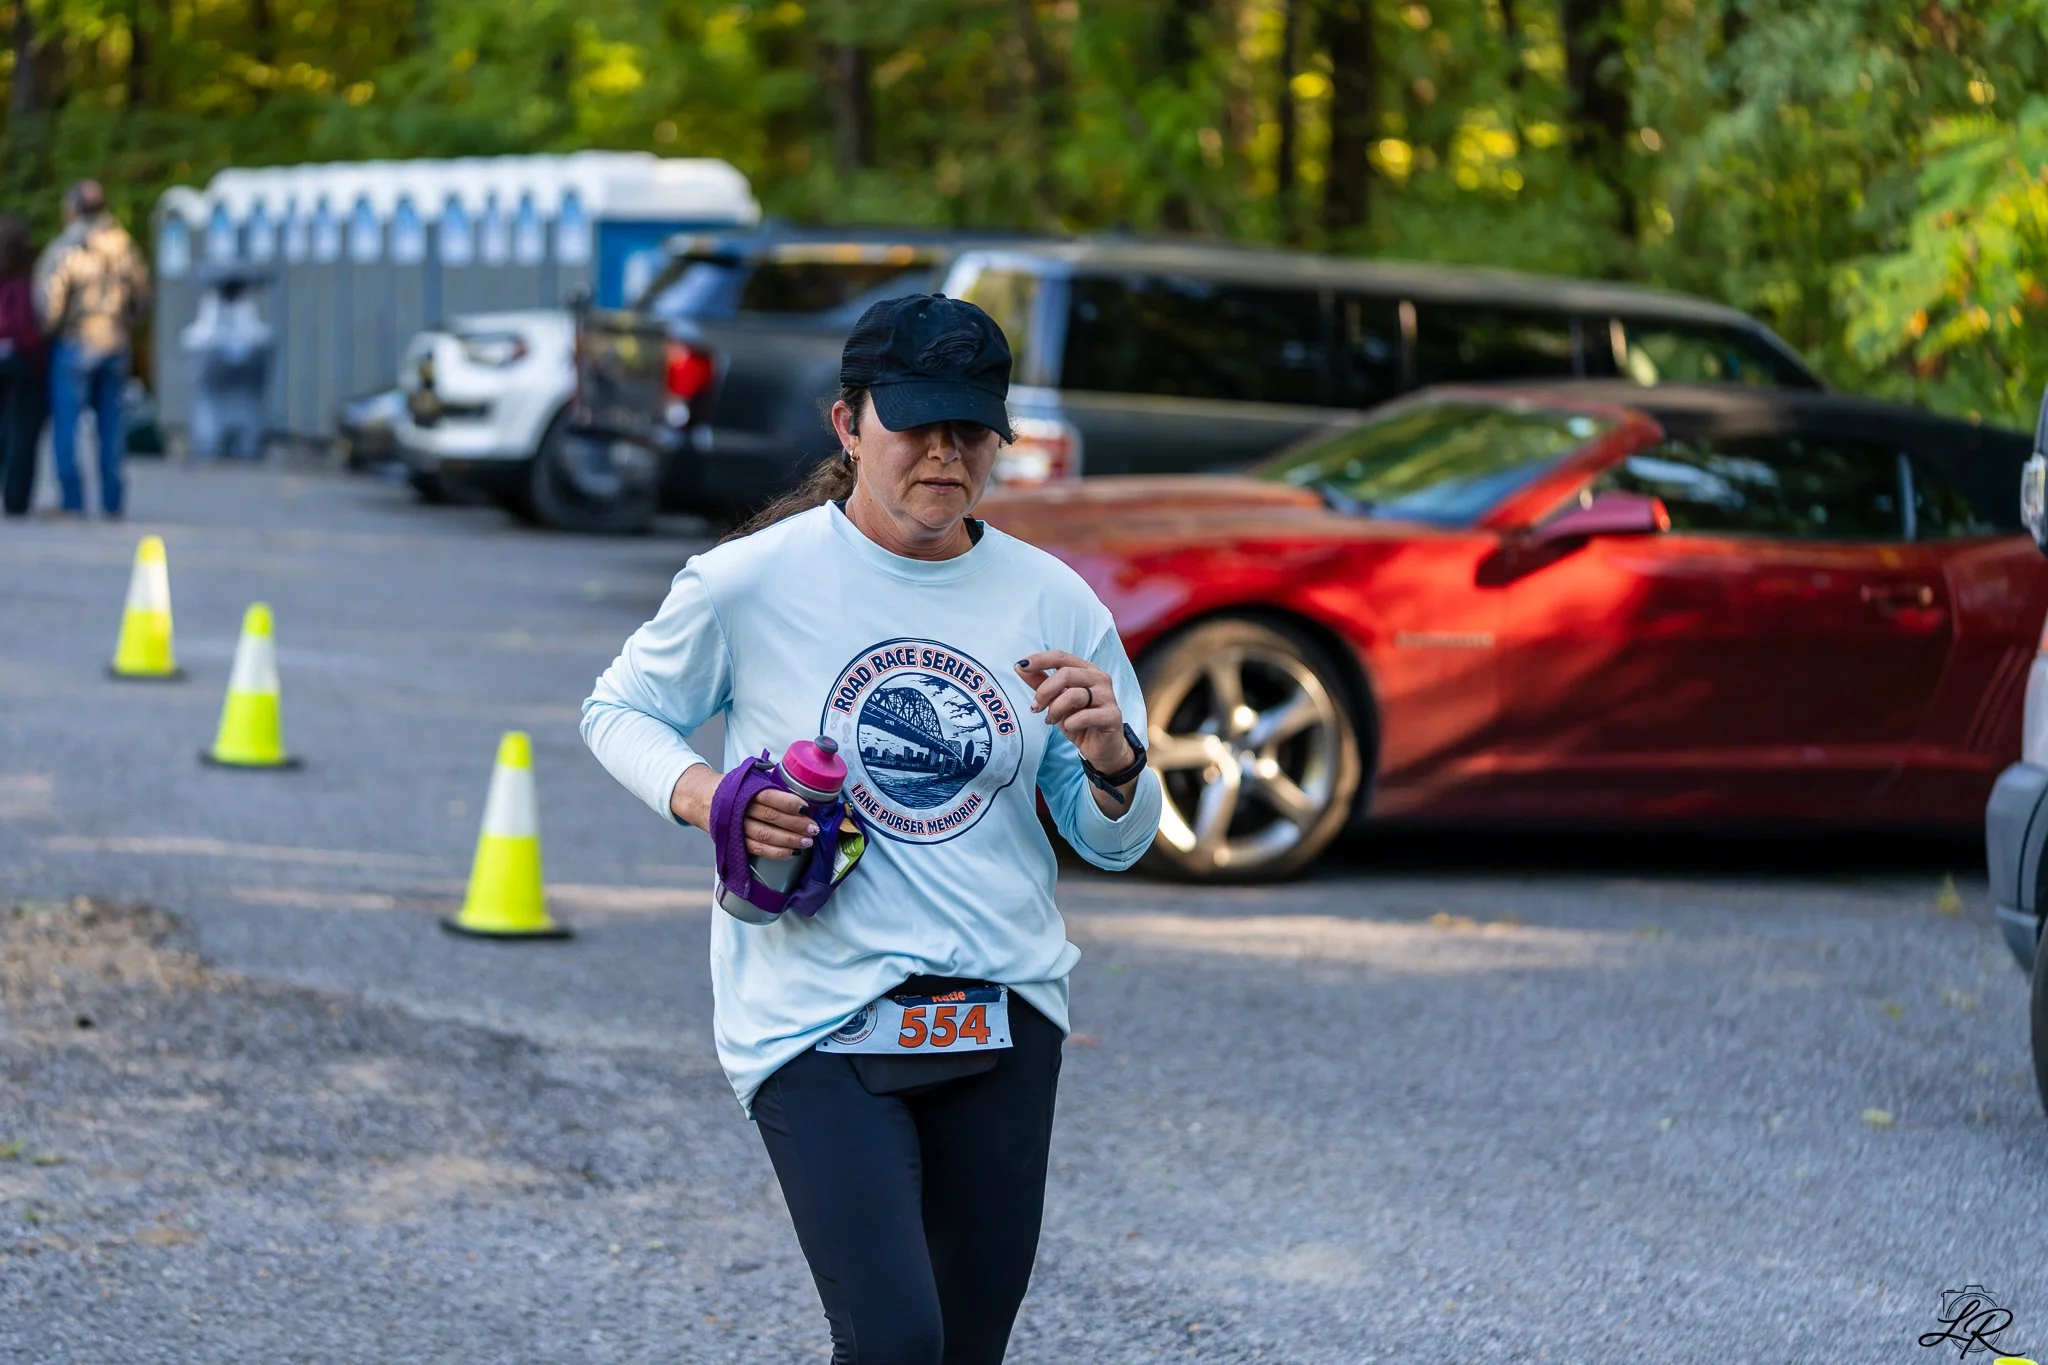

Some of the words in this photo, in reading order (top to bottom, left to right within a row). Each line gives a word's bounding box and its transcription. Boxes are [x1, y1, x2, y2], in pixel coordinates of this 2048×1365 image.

[832, 665, 874, 713] ROAD
[869, 647, 918, 674] RACE
[920, 649, 985, 691] SERIES
[979, 686, 1015, 735] 2026
[850, 783, 879, 817] LANE
[879, 810, 925, 834] PURSER
[927, 792, 983, 835] MEMORIAL
[932, 991, 966, 1003] Katie
[898, 1005, 991, 1048] 554
